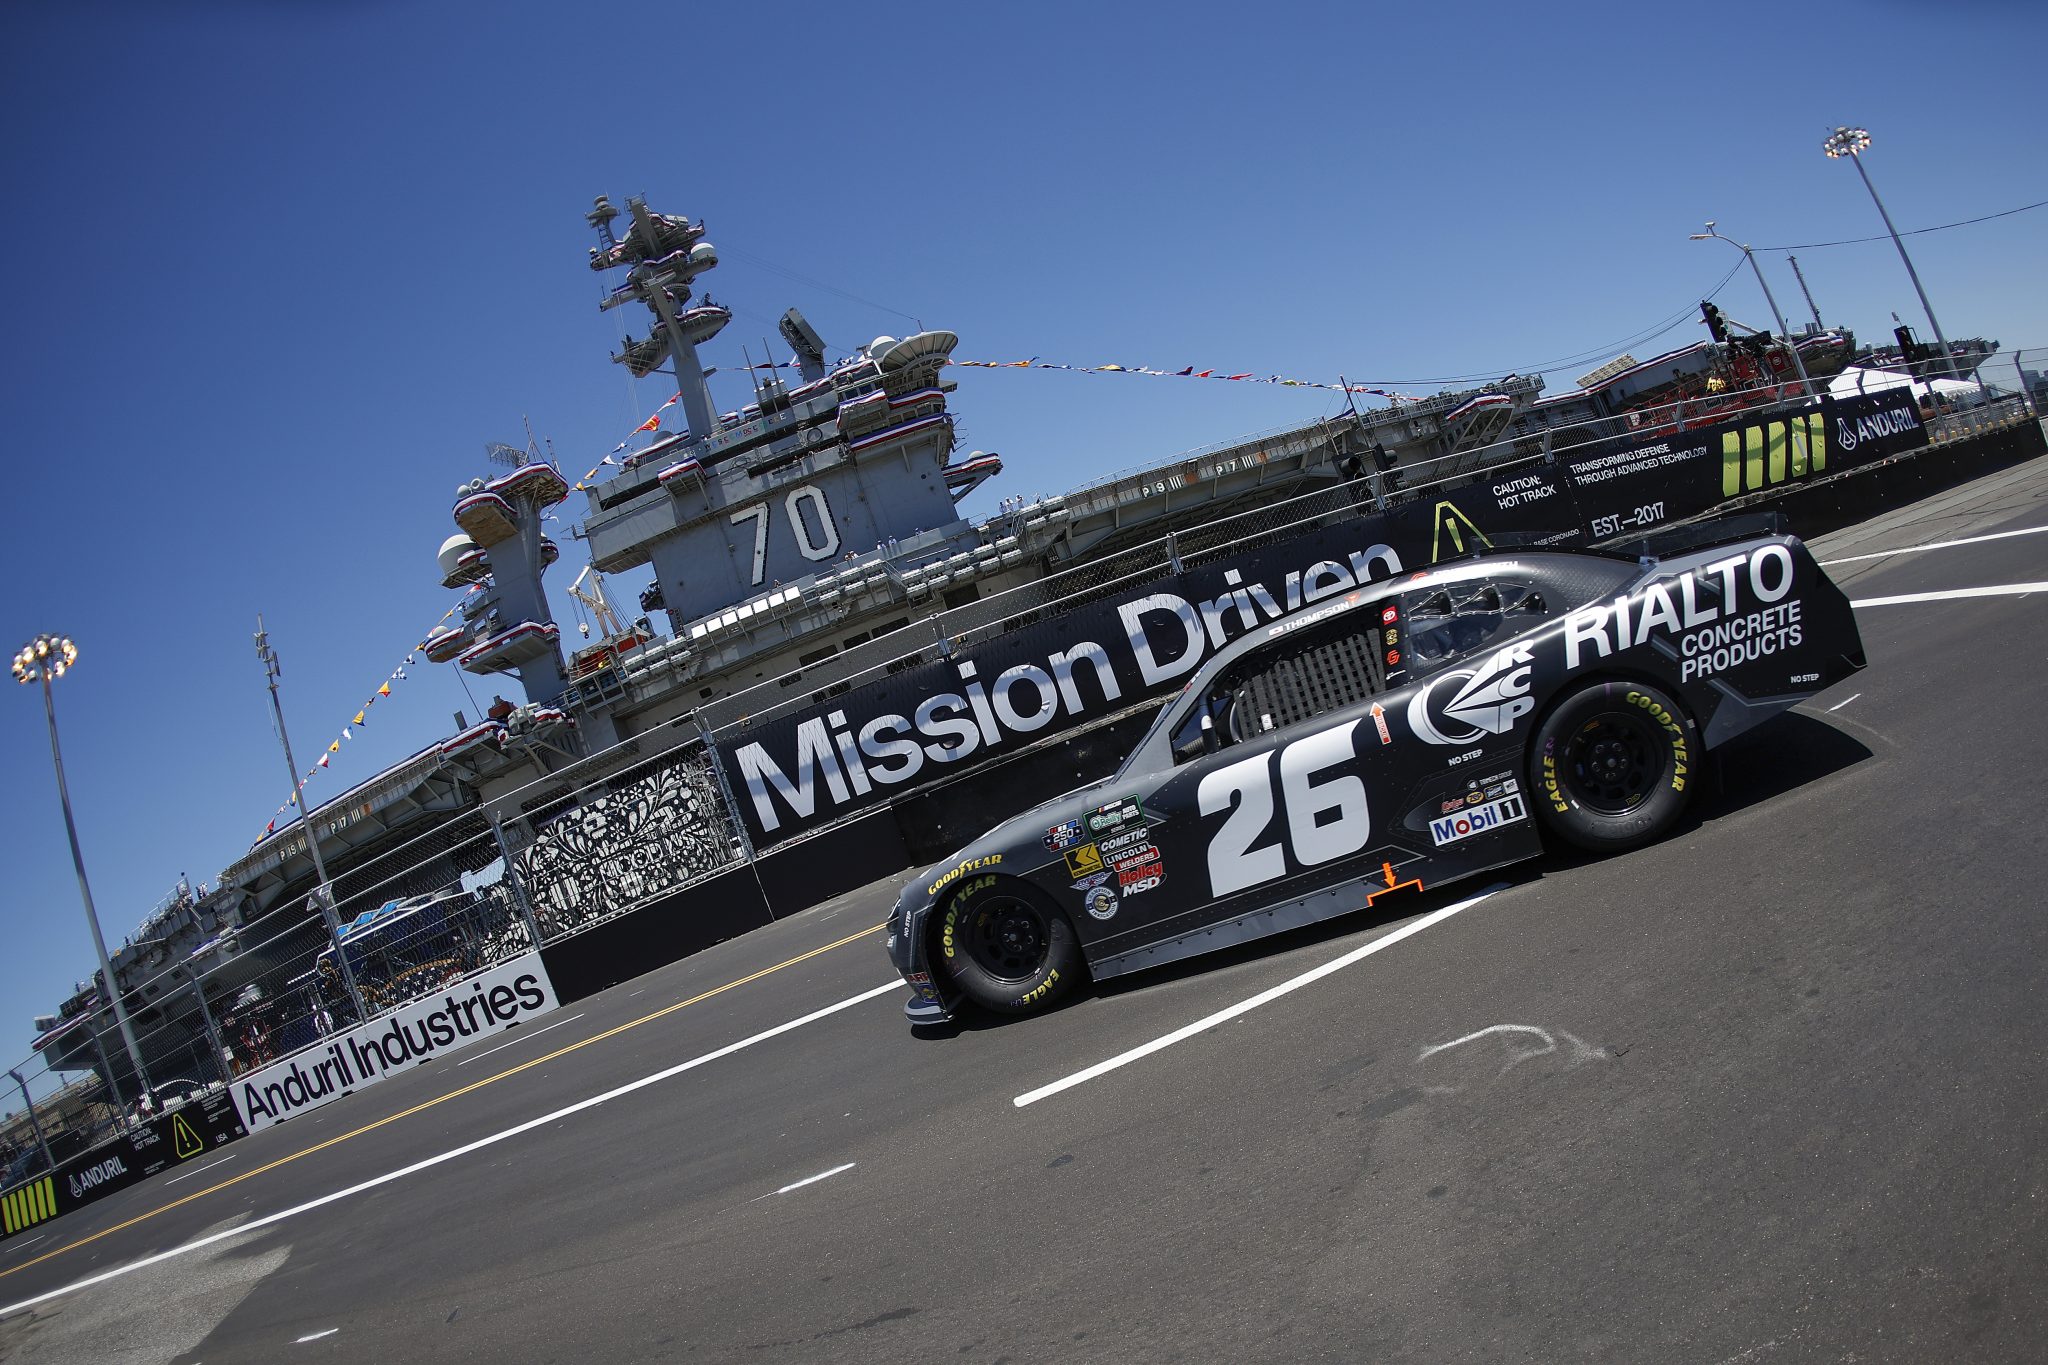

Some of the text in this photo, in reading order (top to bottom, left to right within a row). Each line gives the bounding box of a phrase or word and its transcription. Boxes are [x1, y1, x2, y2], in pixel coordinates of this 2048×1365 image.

[1856, 406, 1919, 442] ANDURIL
[1570, 443, 1671, 475] TRANSFORMING DEFENSE
[1575, 446, 1708, 486] THROUGH ADVANCED TECHNOLOGY
[1493, 474, 1542, 496] CAUTION:
[1498, 484, 1557, 509] HOT TRACK
[730, 485, 842, 587] 70
[1548, 528, 1580, 544] CORONADO
[1282, 601, 1350, 631] THOMPSON
[1564, 544, 1794, 670] RIALTO
[1681, 600, 1801, 657] CONCRETE
[1681, 625, 1802, 684] PRODUCTS
[735, 542, 1403, 832] Mission Driven
[1791, 673, 1819, 684] NO STEP
[1626, 691, 1688, 792] GOODYEAR
[1448, 749, 1483, 766] NO STEP
[1543, 755, 1569, 813] EAGLE
[1122, 804, 1136, 814] AUTO
[1122, 810, 1140, 820] PARTS
[1197, 718, 1370, 898] 26
[1433, 806, 1498, 842] Mobil
[1504, 801, 1516, 818] 1
[1053, 828, 1074, 842] 250
[1101, 828, 1147, 852] COMETIC
[1106, 844, 1148, 864] LINCOLN
[1119, 852, 1155, 869] WELDERS
[928, 854, 1003, 895] GOODYEAR
[1119, 861, 1163, 887] Holley
[1123, 876, 1161, 898] MSD
[943, 875, 998, 958] GOODYEAR
[904, 928, 910, 938] NO
[1022, 968, 1060, 1006] EAGLE
[244, 973, 545, 1126] Anduril Industries
[134, 1133, 161, 1151] HOT TRACK
[216, 1133, 228, 1143] USA
[81, 1155, 128, 1191] ANDURIL
